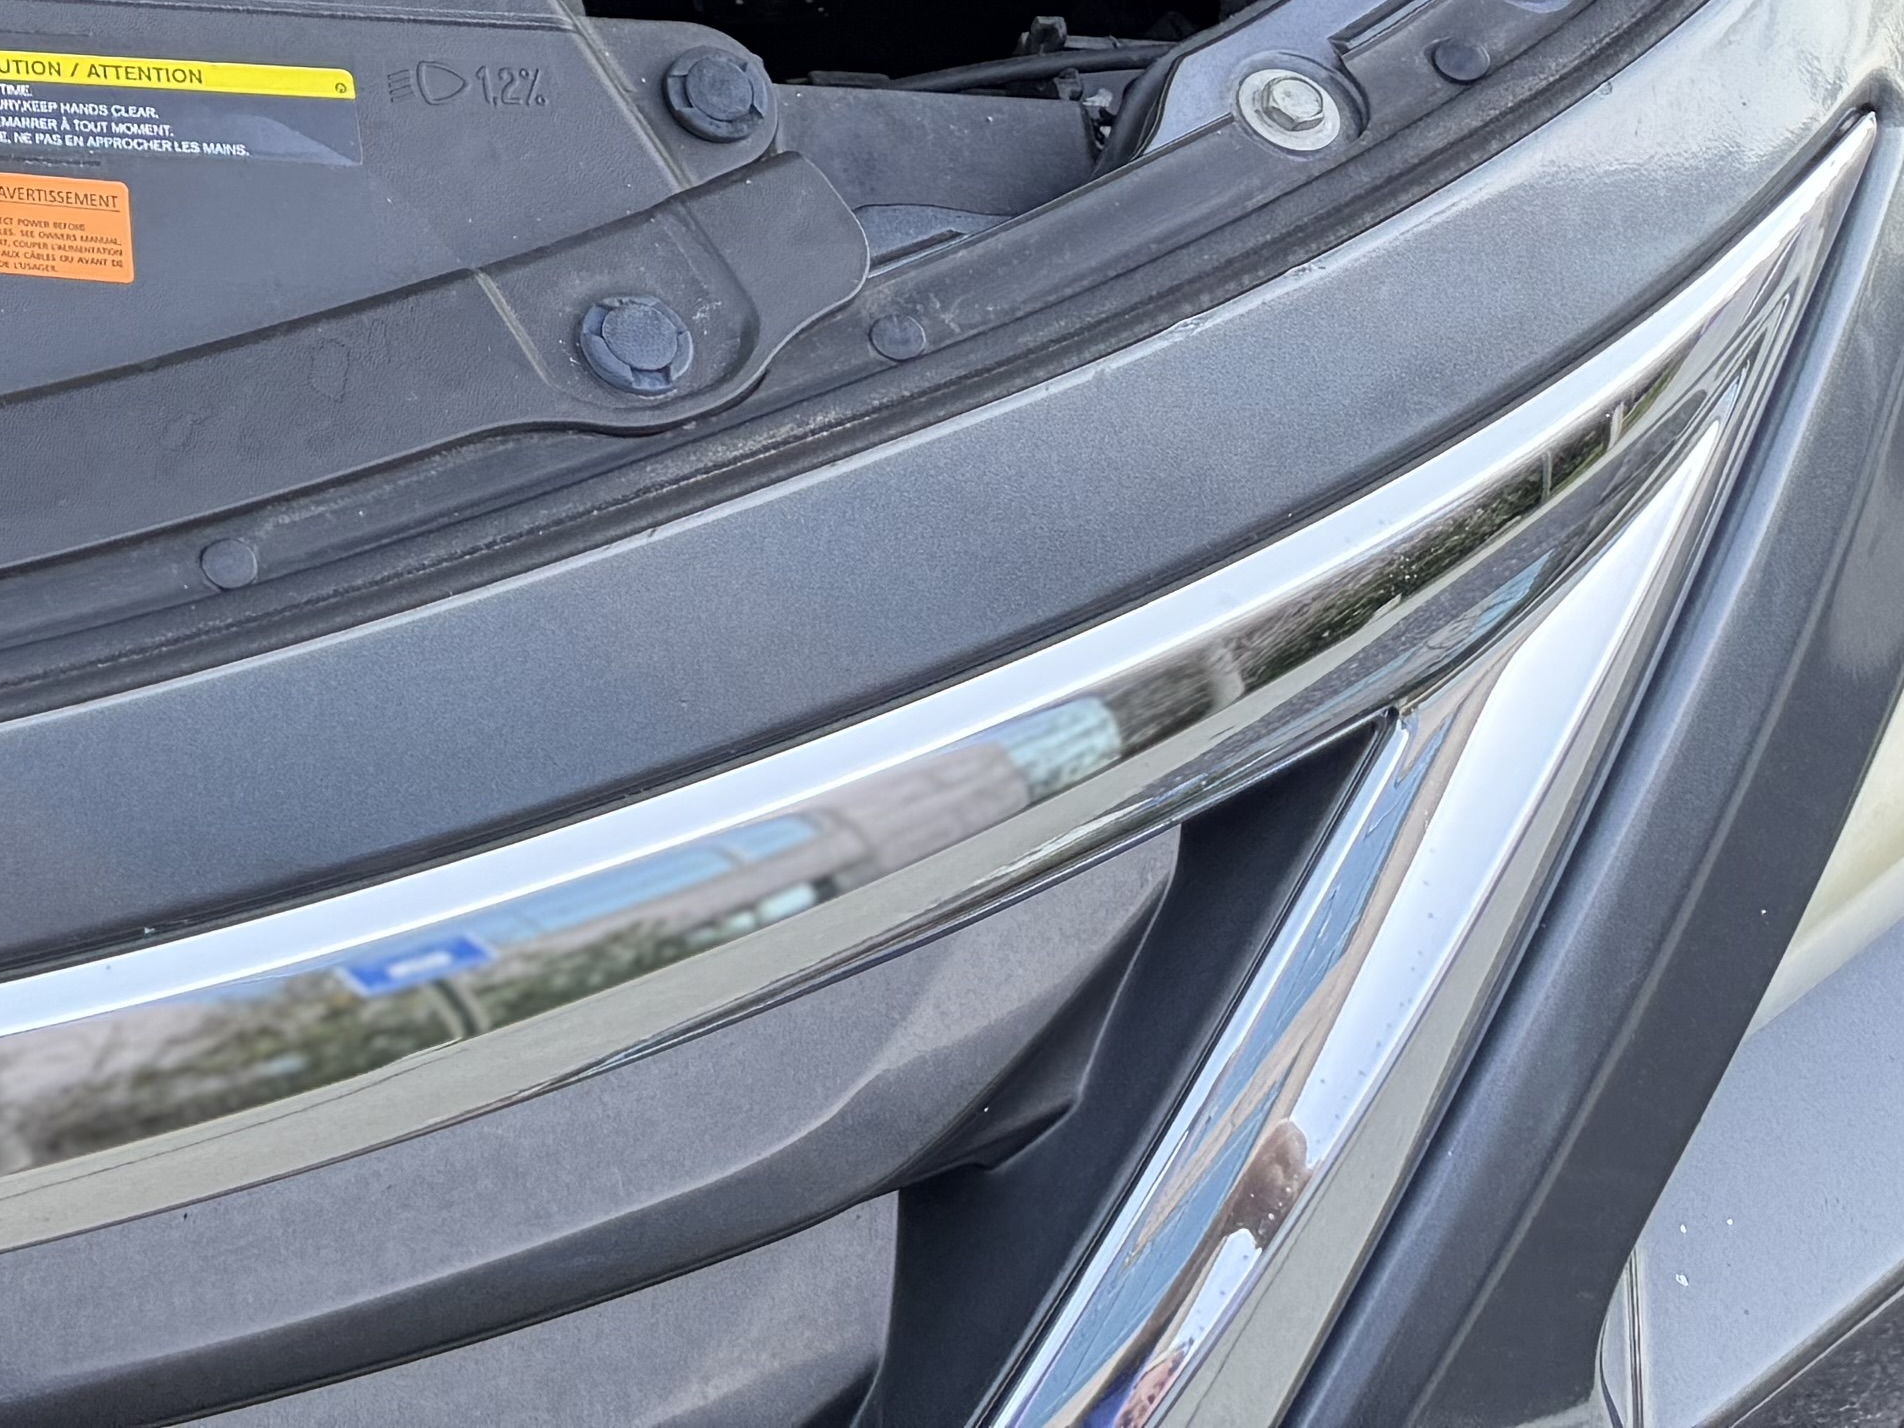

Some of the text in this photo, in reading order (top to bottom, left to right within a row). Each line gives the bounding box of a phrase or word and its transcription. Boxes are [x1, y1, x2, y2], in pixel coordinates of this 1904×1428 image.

[70, 63, 79, 77] /
[87, 63, 202, 84] ATTENTION
[60, 102, 108, 116] HANDS
[110, 105, 159, 118] CLEAR.
[73, 120, 108, 133] TOUT
[111, 122, 174, 136] MOMENT.
[14, 132, 32, 144] NE
[35, 133, 62, 145] PAS
[65, 135, 84, 146] EN
[86, 136, 172, 151] APPROCHER
[174, 141, 200, 153] LES
[202, 143, 249, 156] MAINS.
